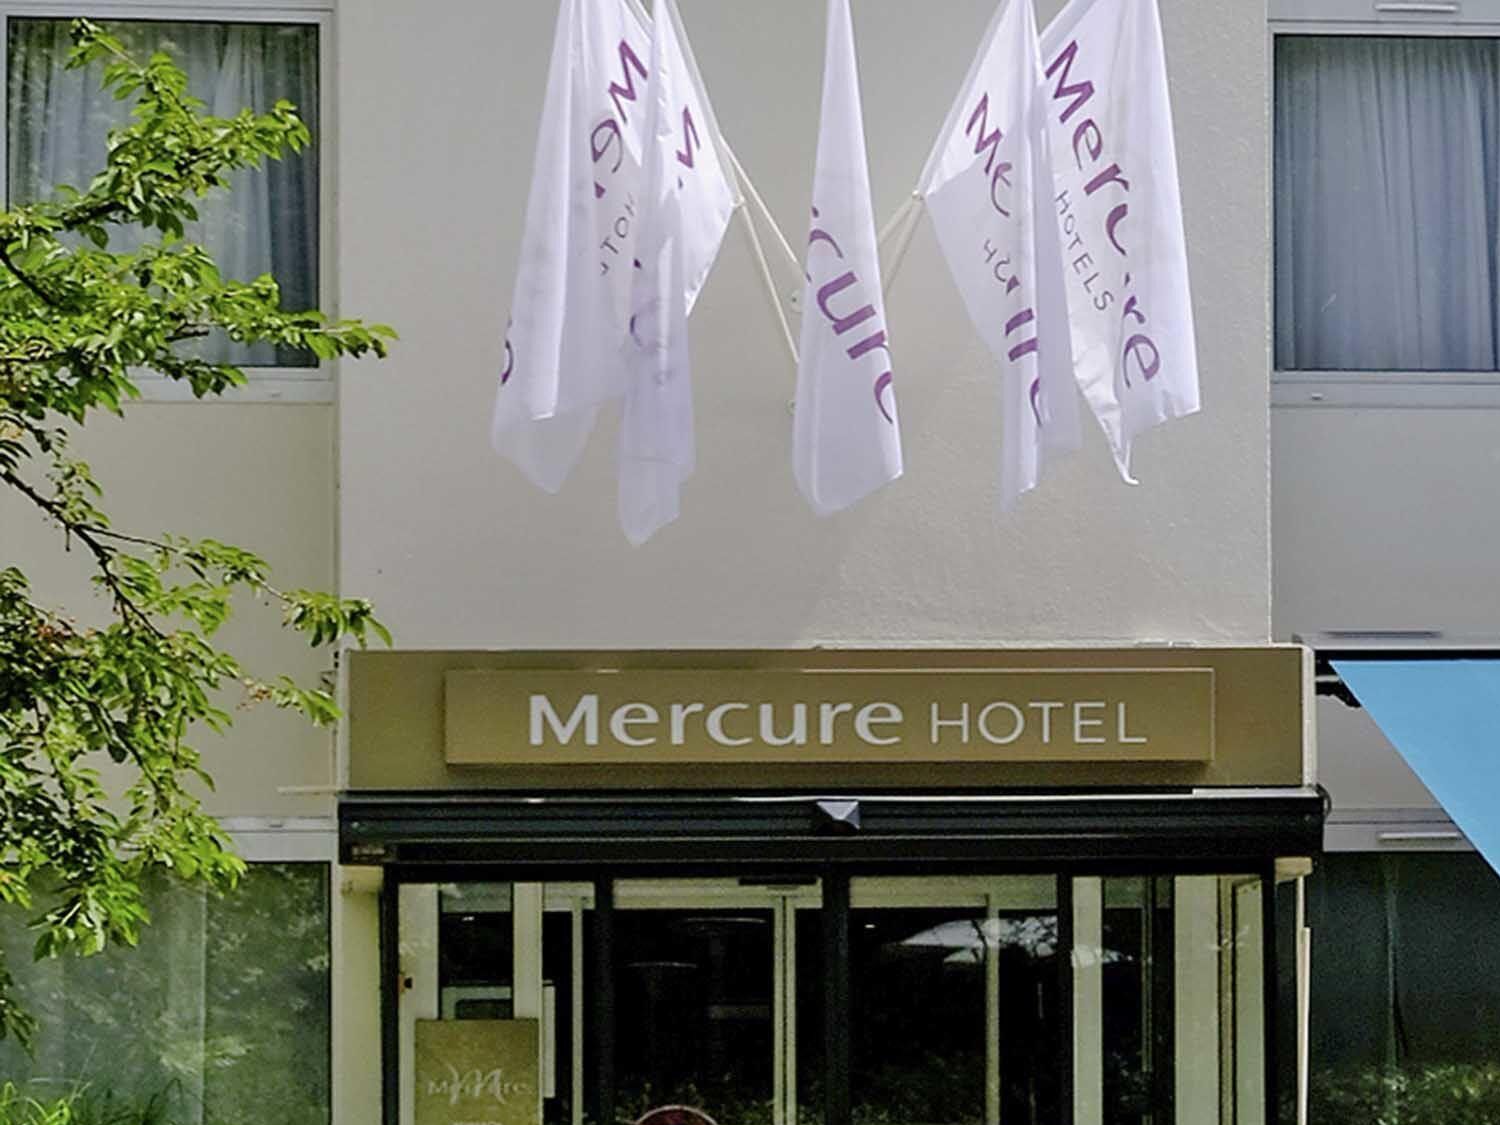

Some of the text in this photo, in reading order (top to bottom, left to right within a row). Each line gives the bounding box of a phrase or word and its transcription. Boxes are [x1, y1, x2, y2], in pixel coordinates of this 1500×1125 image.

[1044, 40, 1161, 388] Mercre
[1055, 189, 1114, 312] HOTELS
[528, 693, 1149, 747] Mercure HOTEL
